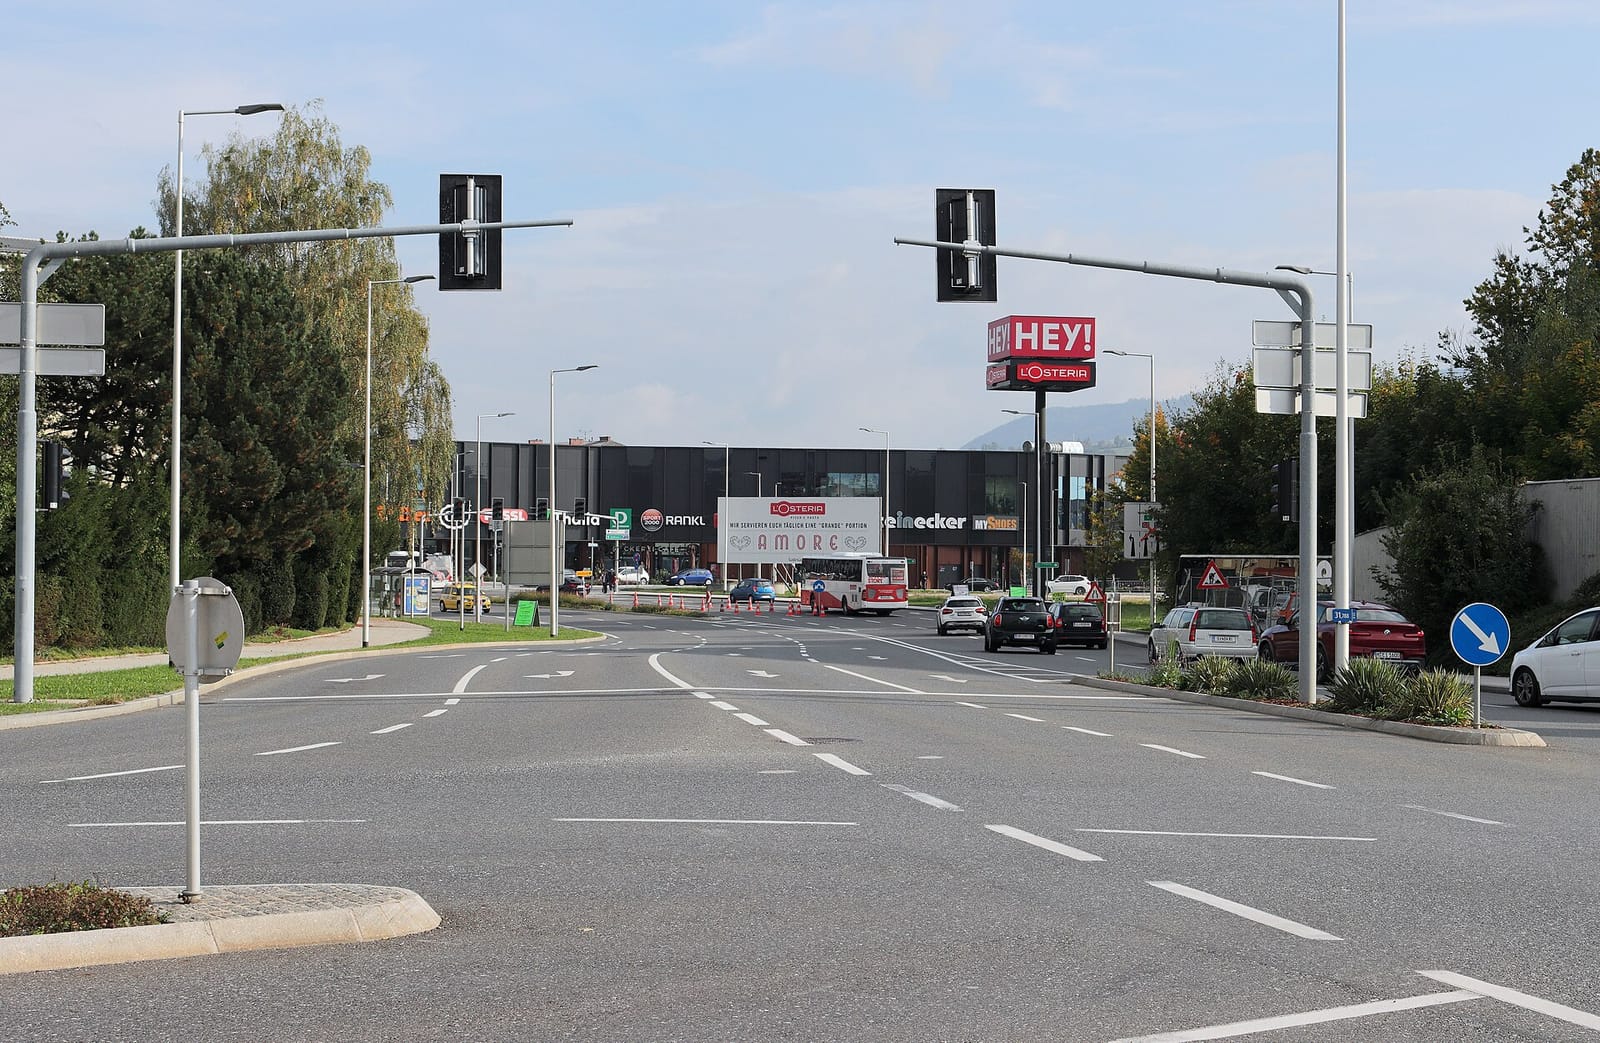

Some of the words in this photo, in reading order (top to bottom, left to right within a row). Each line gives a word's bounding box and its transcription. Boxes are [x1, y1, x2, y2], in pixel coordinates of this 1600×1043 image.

[988, 322, 1010, 356] HEY!
[1015, 322, 1092, 352] HEY!
[1020, 365, 1088, 379] L'OSTERIA
[484, 510, 525, 521] FSSL
[772, 503, 824, 515] L'OSTERIA
[665, 515, 706, 526] RANKL
[758, 534, 839, 551] AMORE
